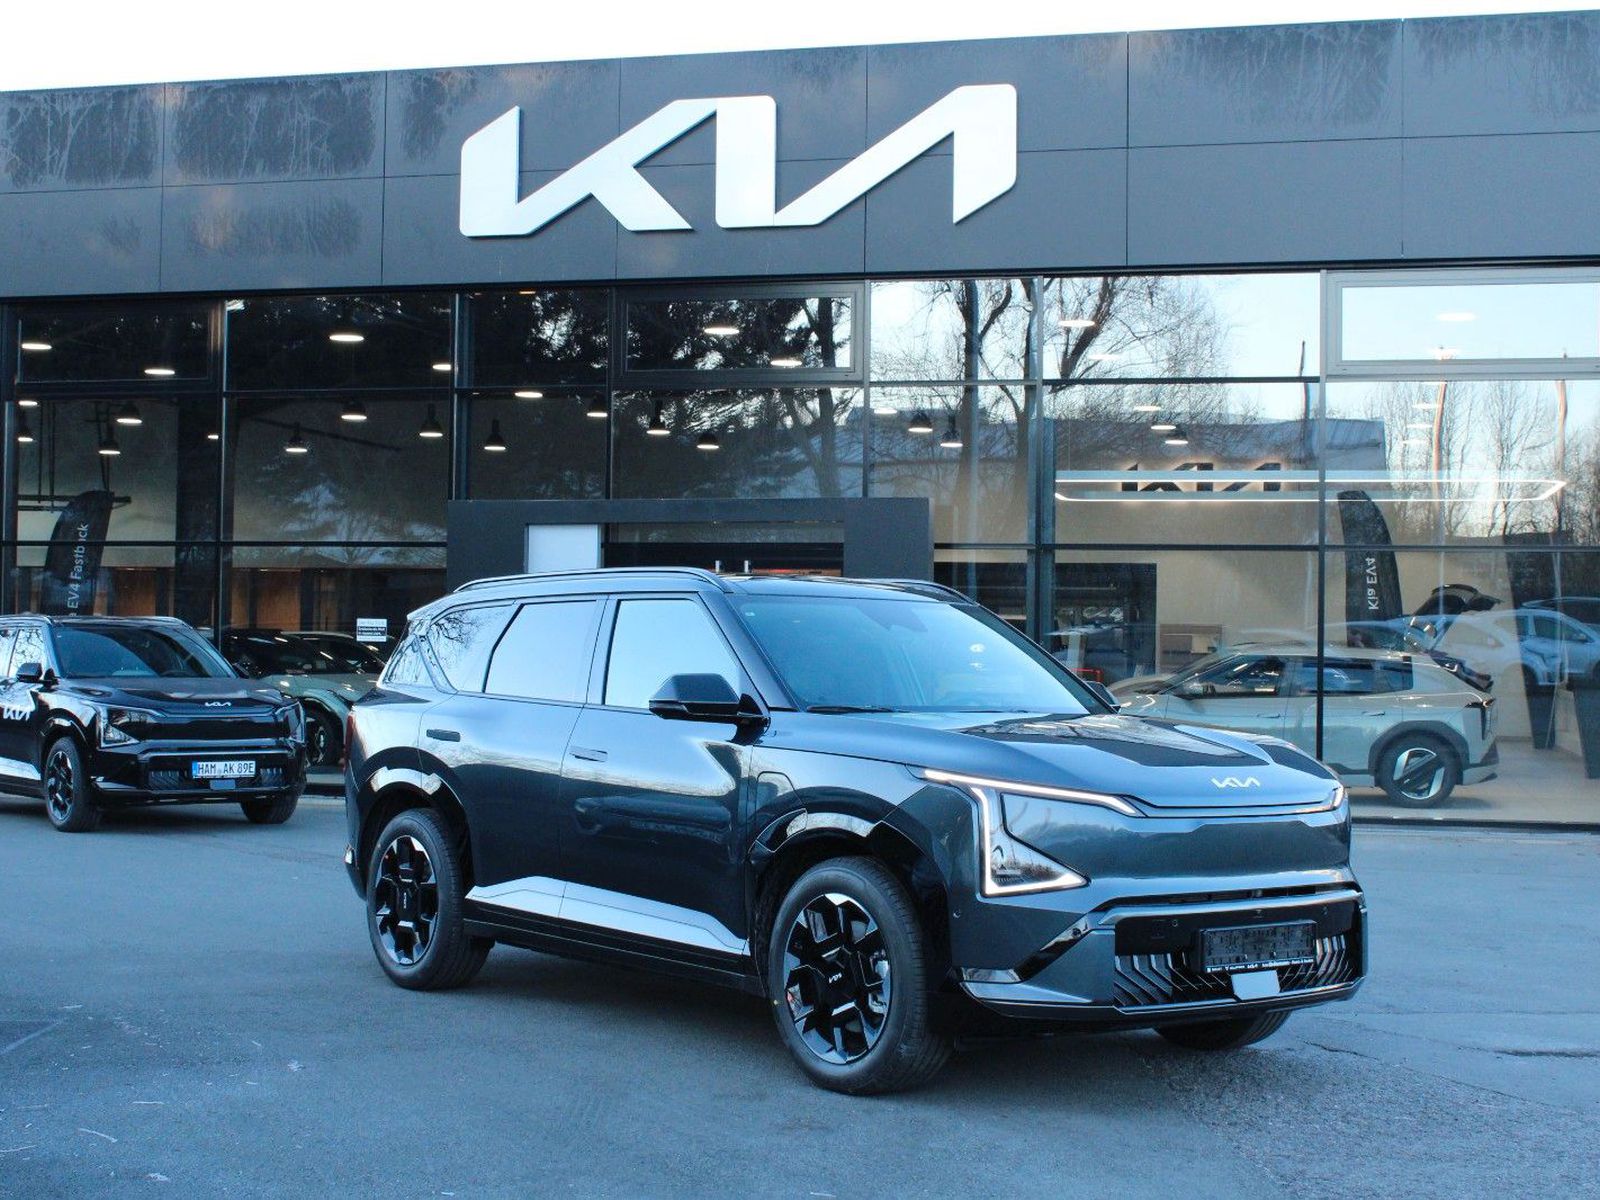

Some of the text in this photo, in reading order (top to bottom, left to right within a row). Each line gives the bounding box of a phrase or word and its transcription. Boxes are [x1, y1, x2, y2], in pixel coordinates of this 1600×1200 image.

[459, 83, 1018, 238] KIA
[67, 583, 81, 609] EV4
[197, 762, 254, 775] HAM AK 89E
[1210, 776, 1261, 789] KIA
